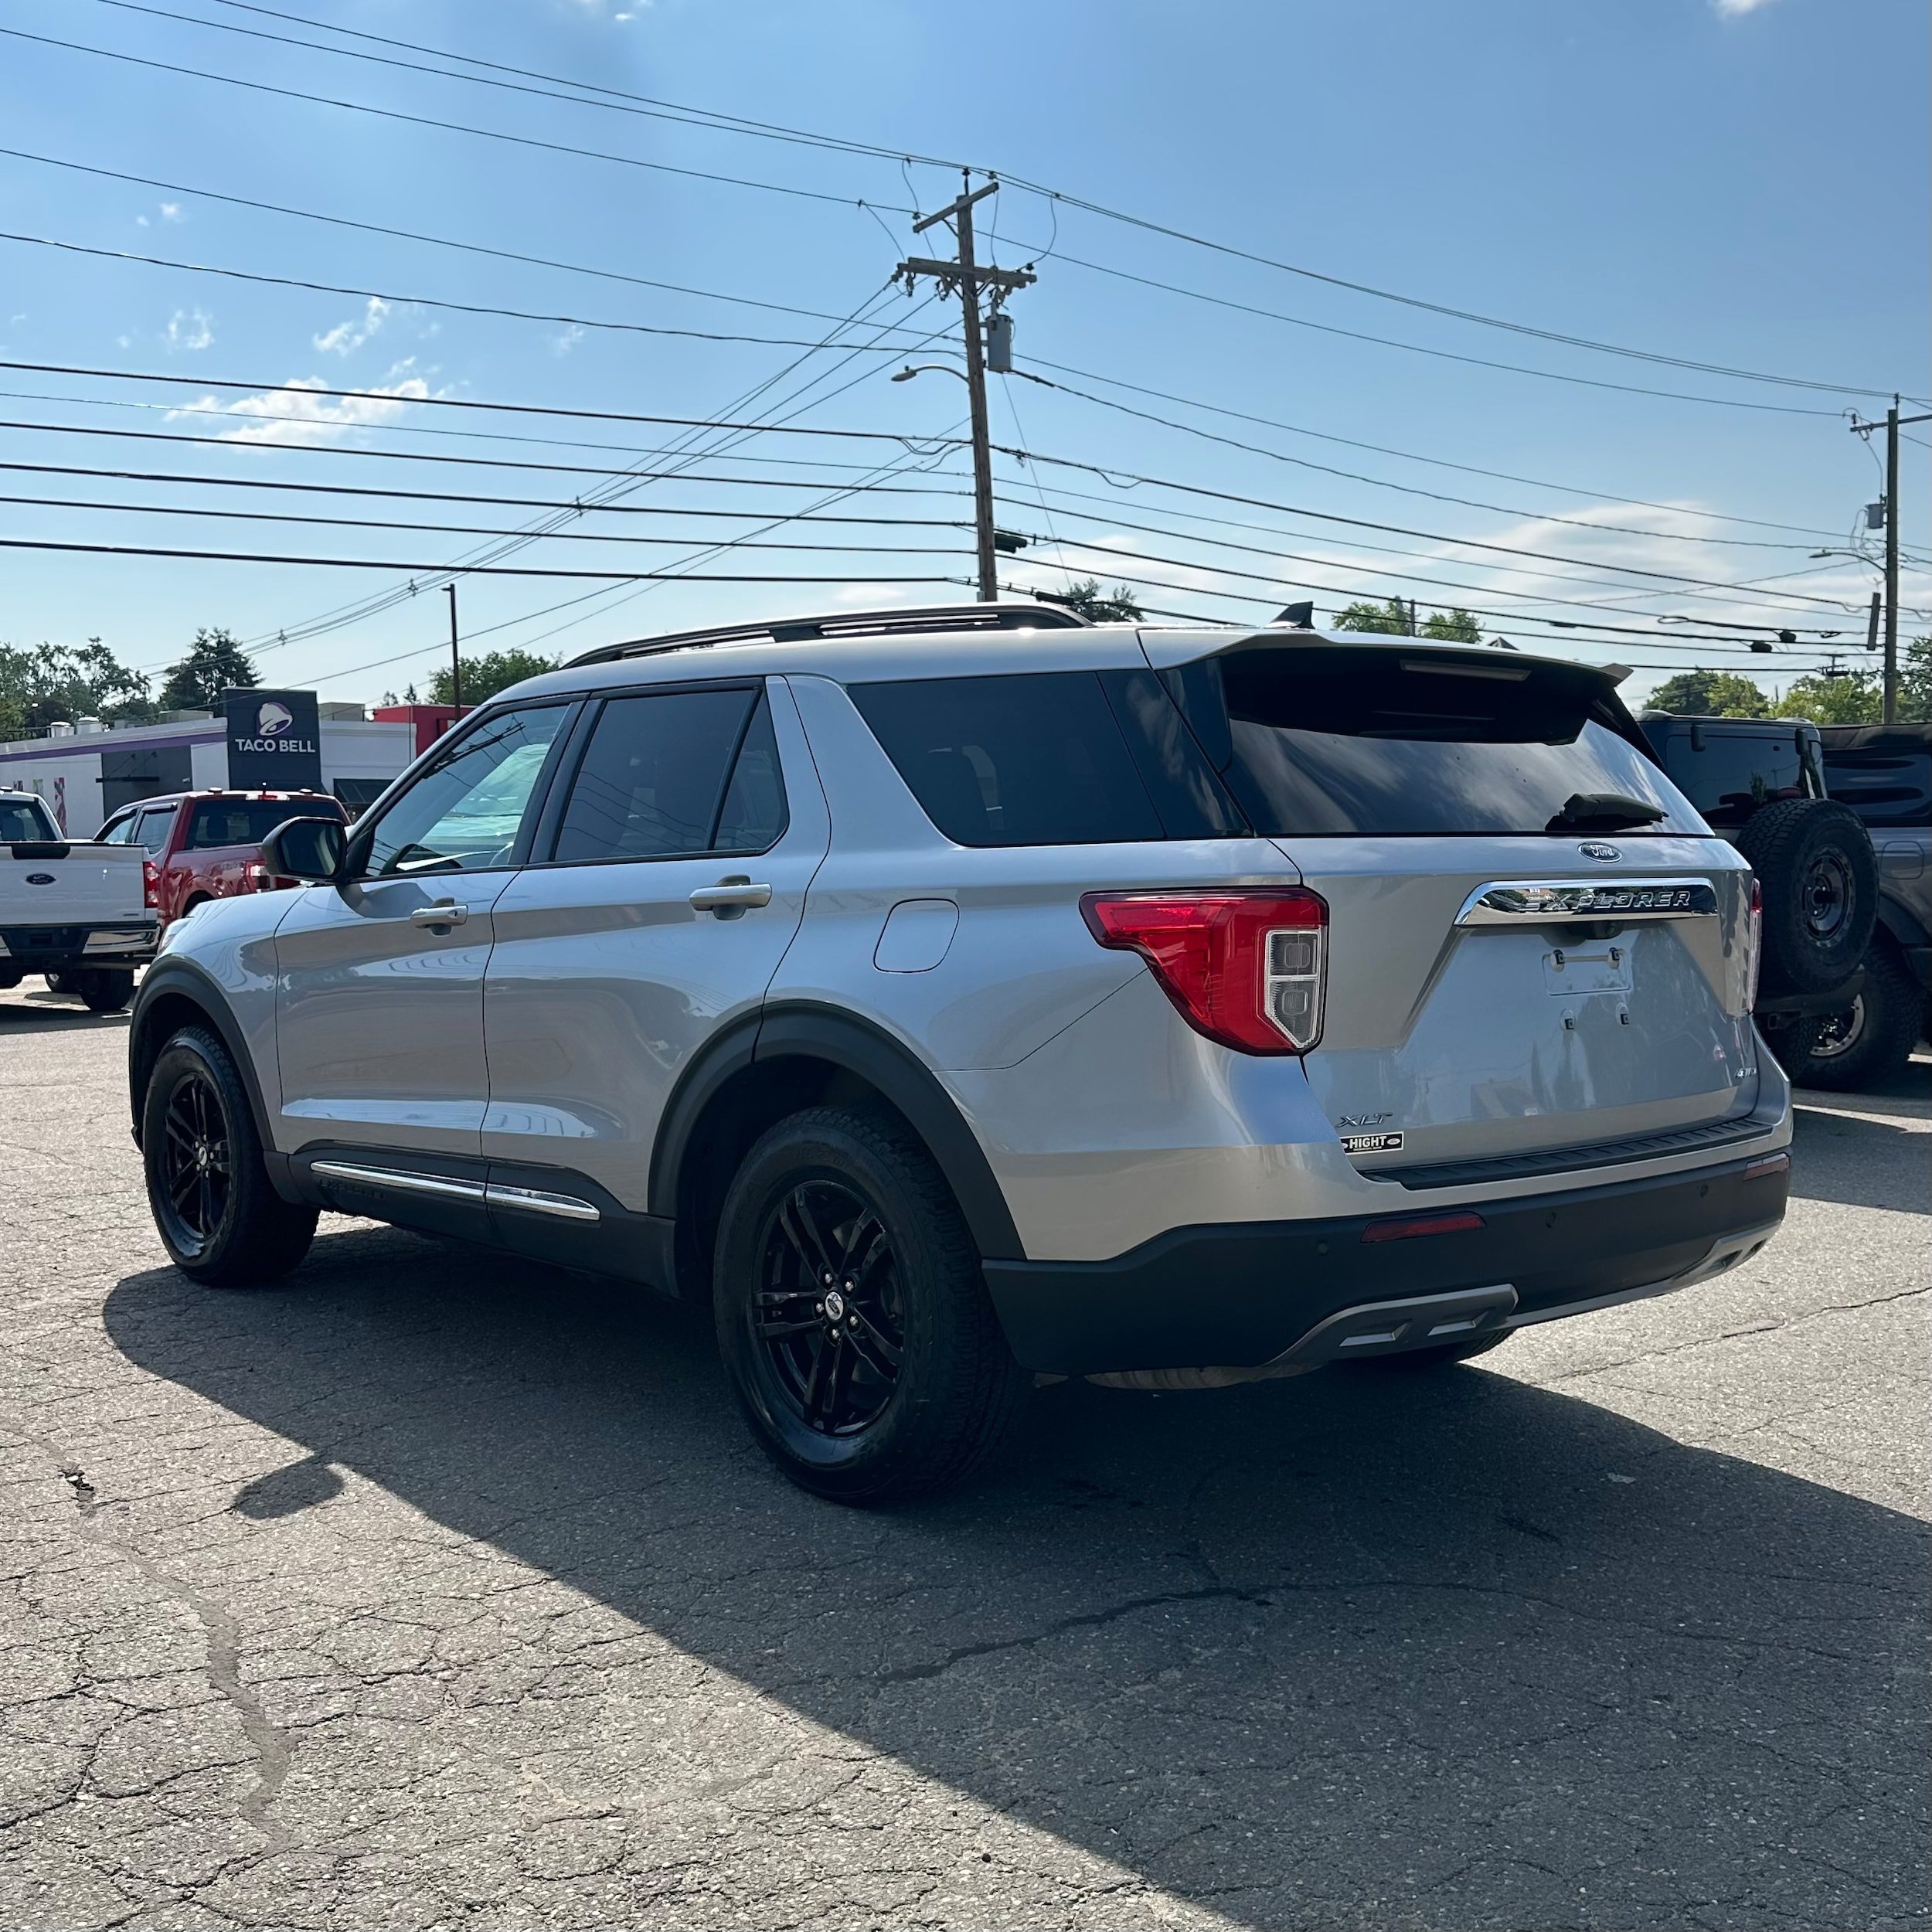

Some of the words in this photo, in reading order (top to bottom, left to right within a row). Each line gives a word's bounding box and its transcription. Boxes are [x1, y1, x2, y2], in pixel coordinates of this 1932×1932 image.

[234, 738, 277, 752] TACO
[279, 740, 316, 753] BELL
[1517, 890, 1691, 912] EXPLORER
[1335, 1112, 1393, 1128] XLT
[1349, 1135, 1387, 1150] HIGHT
